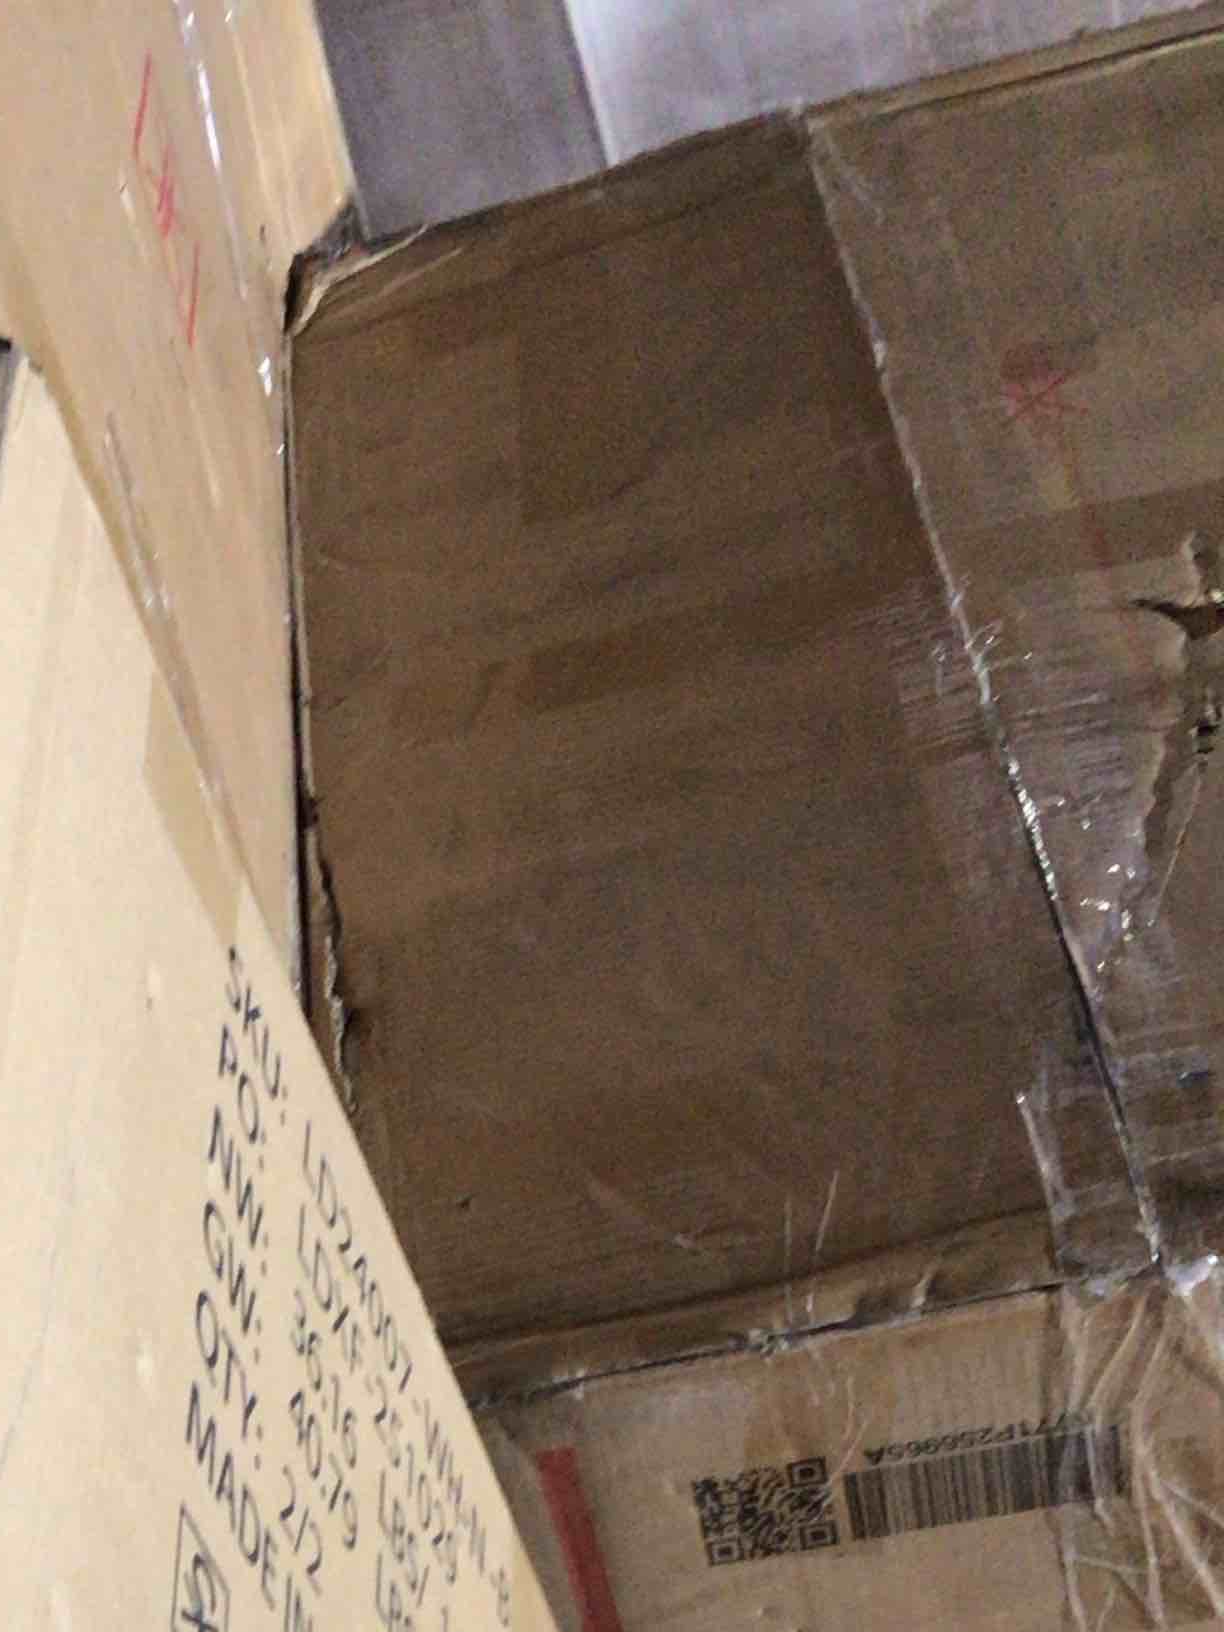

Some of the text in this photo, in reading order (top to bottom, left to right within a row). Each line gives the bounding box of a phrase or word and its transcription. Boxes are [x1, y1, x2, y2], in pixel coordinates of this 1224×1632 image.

[218, 1025, 265, 1167] PO:
[227, 945, 286, 1122] SKU:
[195, 1291, 323, 1593] QTY: 2/2
[203, 1201, 261, 1359] GW:
[289, 1390, 358, 1550] 40.79
[208, 1108, 267, 1271] NW:
[292, 1291, 357, 1468] 36.16
[377, 1471, 429, 1607] LBS/
[186, 1385, 275, 1605] MADE
